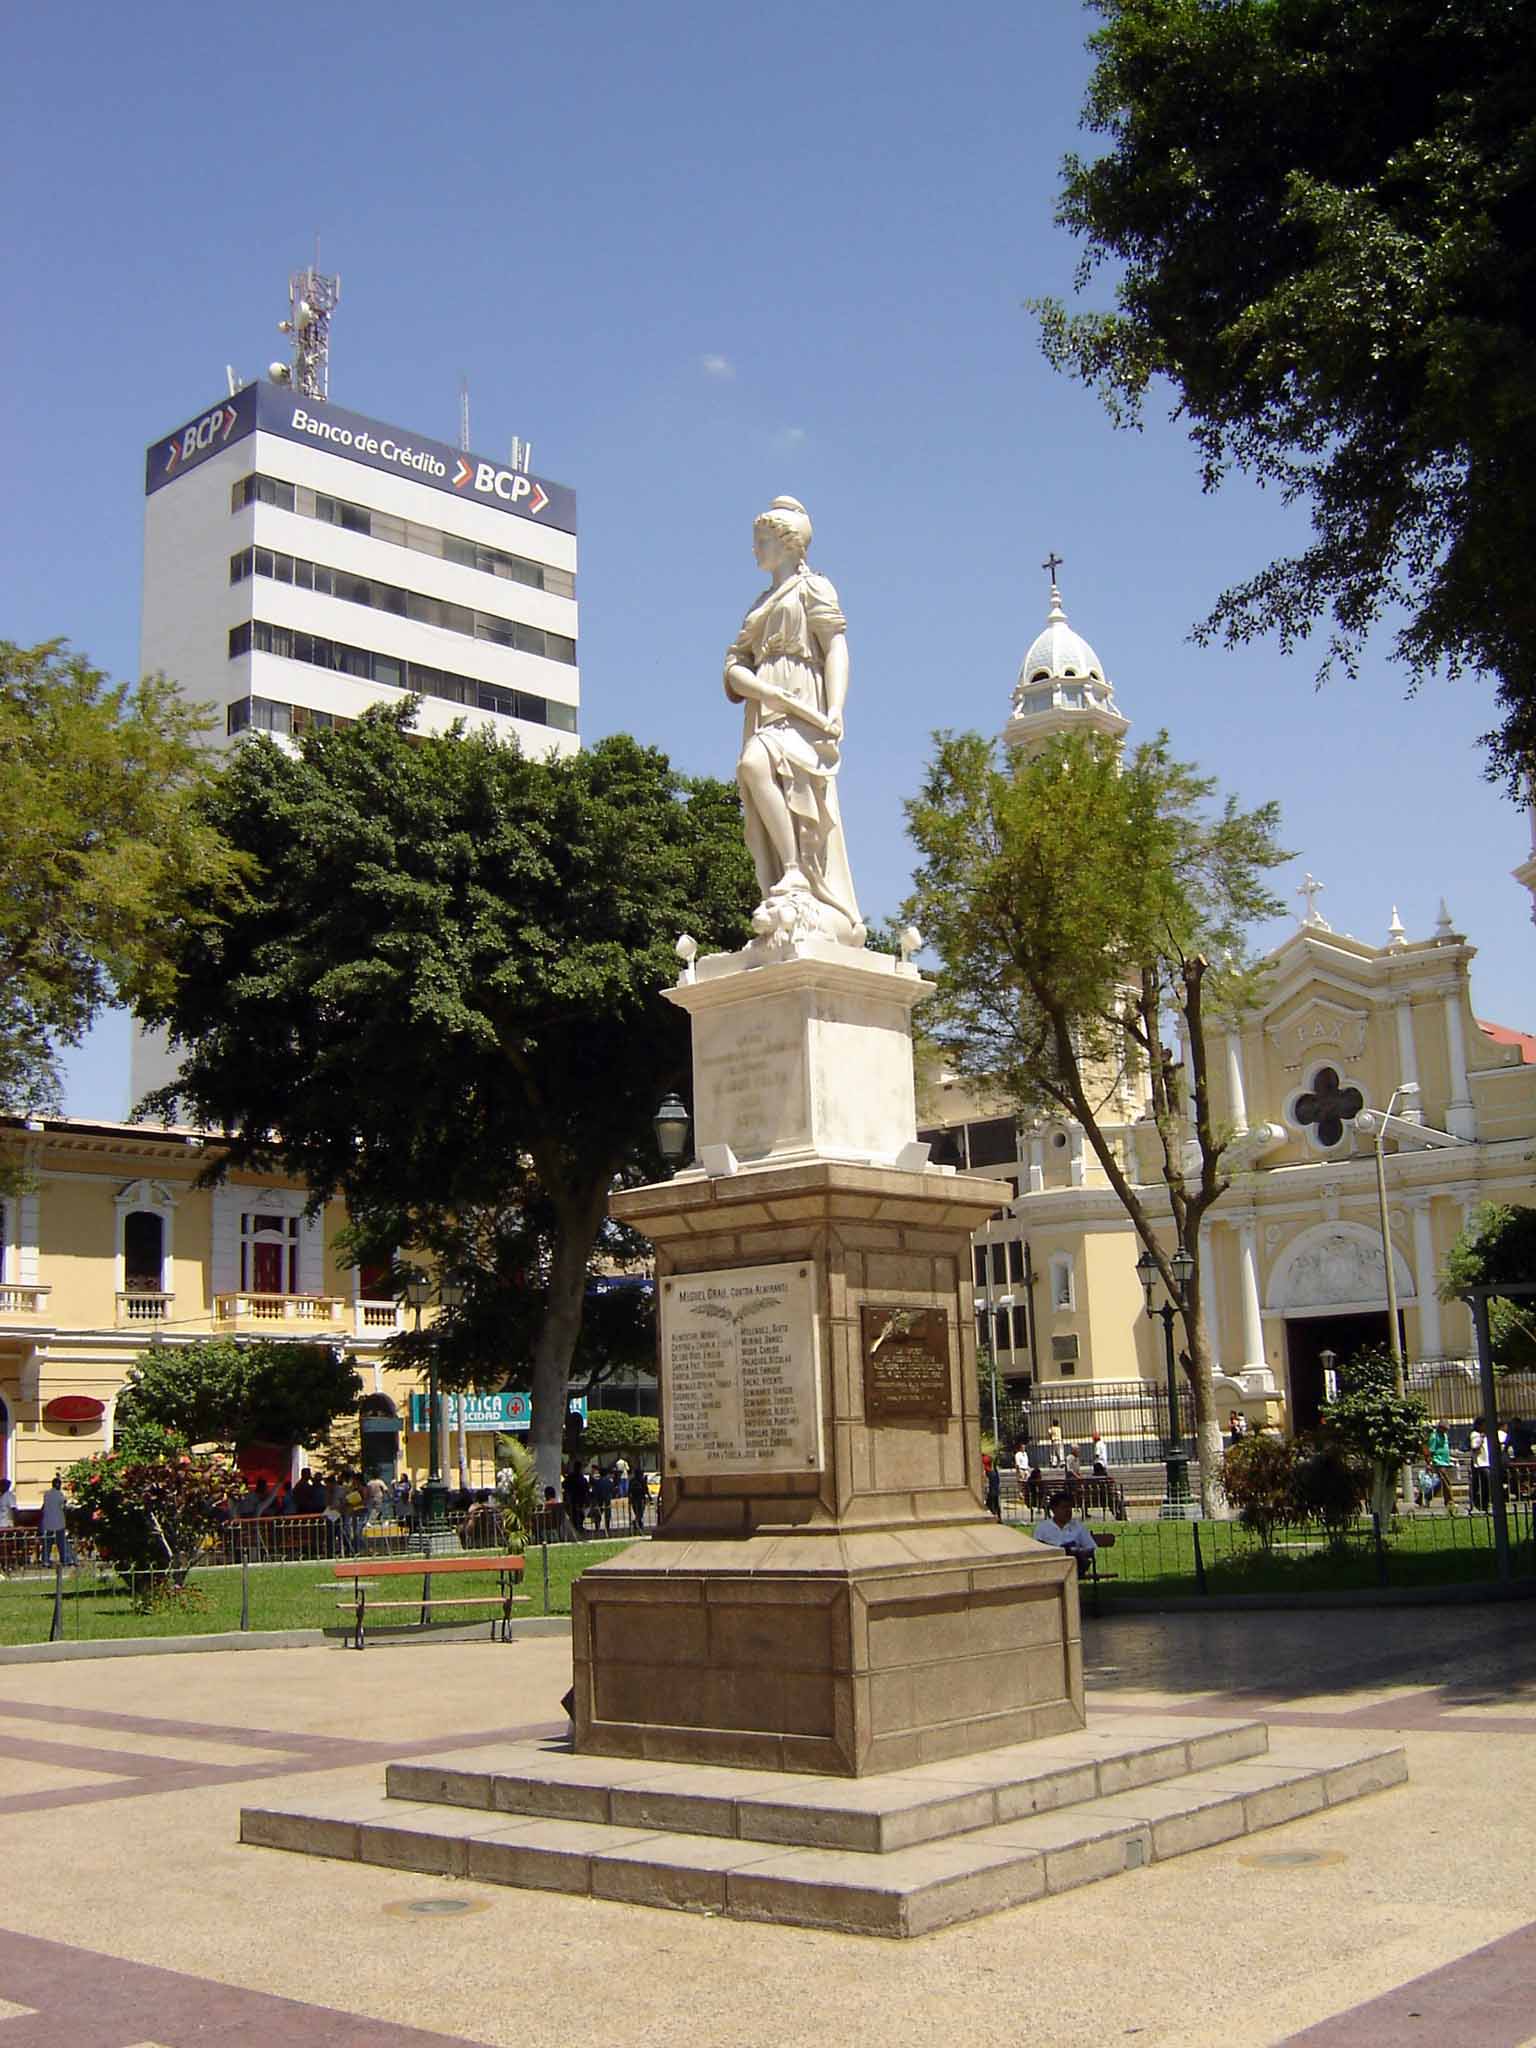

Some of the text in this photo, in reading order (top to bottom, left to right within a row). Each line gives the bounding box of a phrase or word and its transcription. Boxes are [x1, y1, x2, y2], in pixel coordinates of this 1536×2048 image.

[182, 409, 222, 461] BCP
[291, 409, 446, 478] Banco de Crédito
[474, 463, 531, 502] BCP
